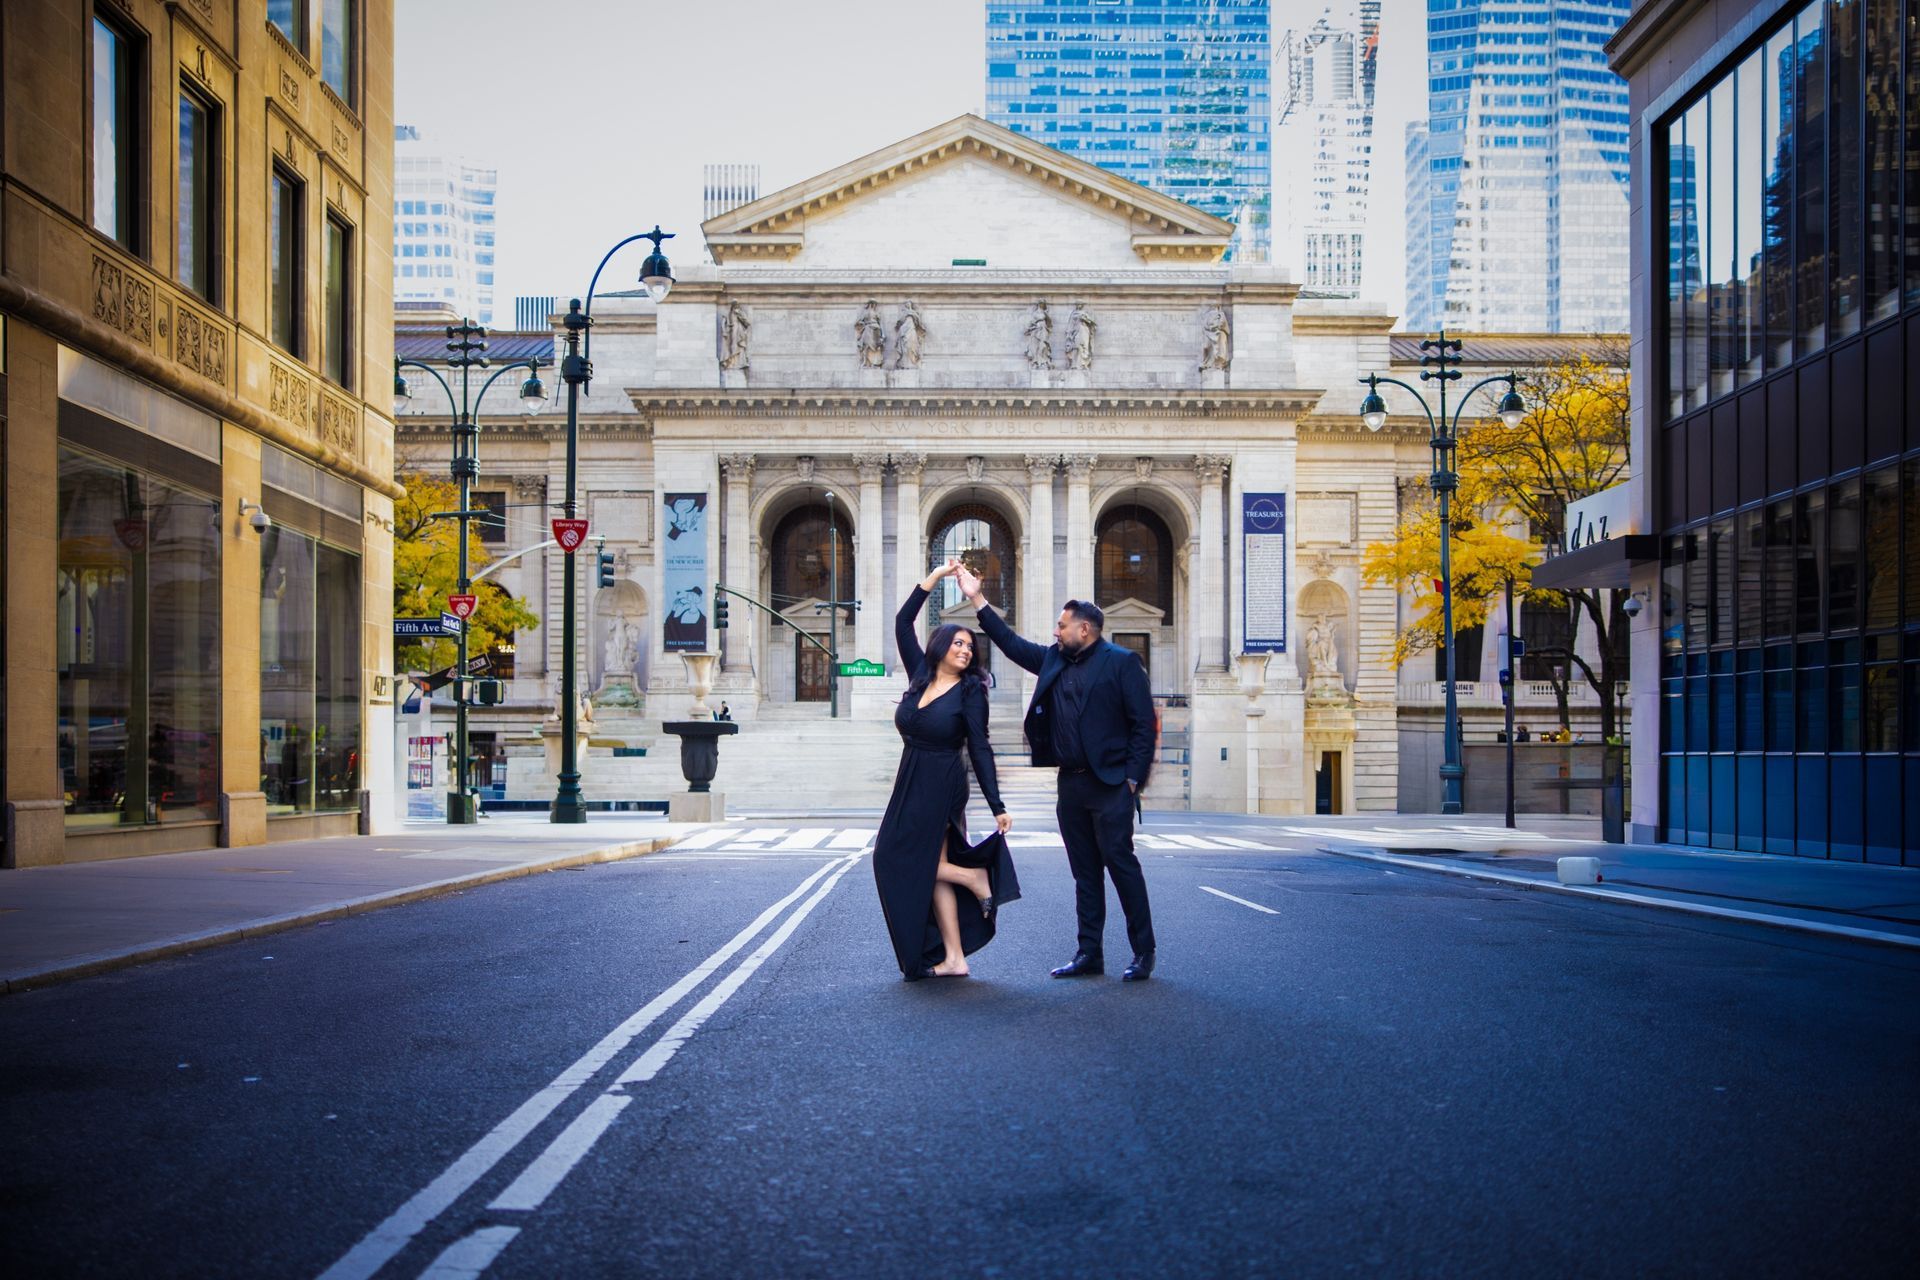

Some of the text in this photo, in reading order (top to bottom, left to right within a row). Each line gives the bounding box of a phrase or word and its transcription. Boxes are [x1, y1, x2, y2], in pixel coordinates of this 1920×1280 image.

[822, 421, 857, 434] THE
[869, 421, 913, 434] NEW
[926, 421, 970, 434] YORK
[984, 421, 1044, 434] PUBLIC
[1055, 421, 1129, 434] LIBRARY
[1245, 510, 1284, 518] TREASURES
[395, 623, 440, 633] Fifth Ave
[847, 666, 878, 674] Fifth Ave
